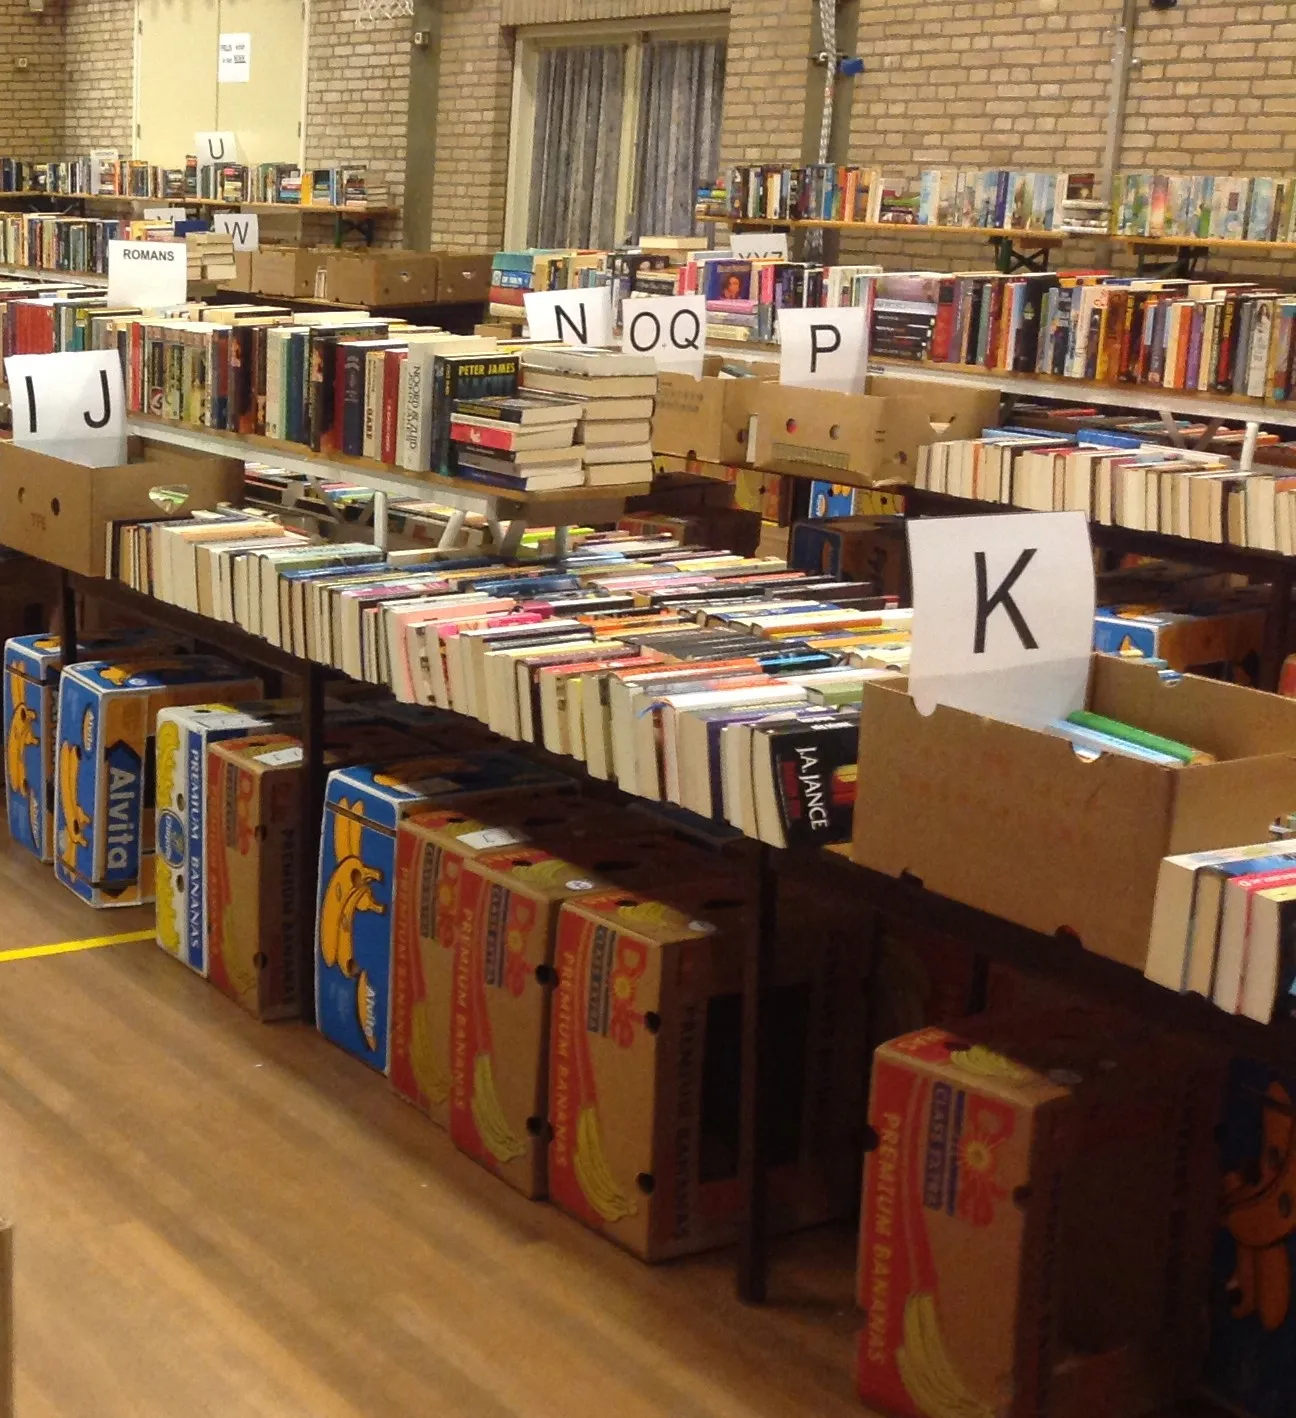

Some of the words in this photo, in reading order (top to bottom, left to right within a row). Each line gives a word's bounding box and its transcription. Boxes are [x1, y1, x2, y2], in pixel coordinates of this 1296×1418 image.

[208, 139, 225, 160] U
[123, 249, 175, 262] ROMANS
[225, 221, 249, 244] W
[458, 364, 485, 377] PETER
[488, 362, 516, 375] JAMES
[554, 302, 589, 345] N
[809, 324, 842, 374] P
[972, 547, 1039, 654] K
[106, 767, 137, 870] Alvita
[189, 749, 201, 841] PREMIUM
[798, 774, 830, 831] JANCE
[189, 855, 201, 949] BANANAS
[456, 908, 474, 1009] PREMIUM
[557, 951, 576, 1058] PREMIUM
[454, 1015, 468, 1111] BANANAS
[555, 1065, 571, 1168] BANANAS
[875, 1111, 902, 1237] PREMIUM
[867, 1245, 893, 1366] BANANAS
